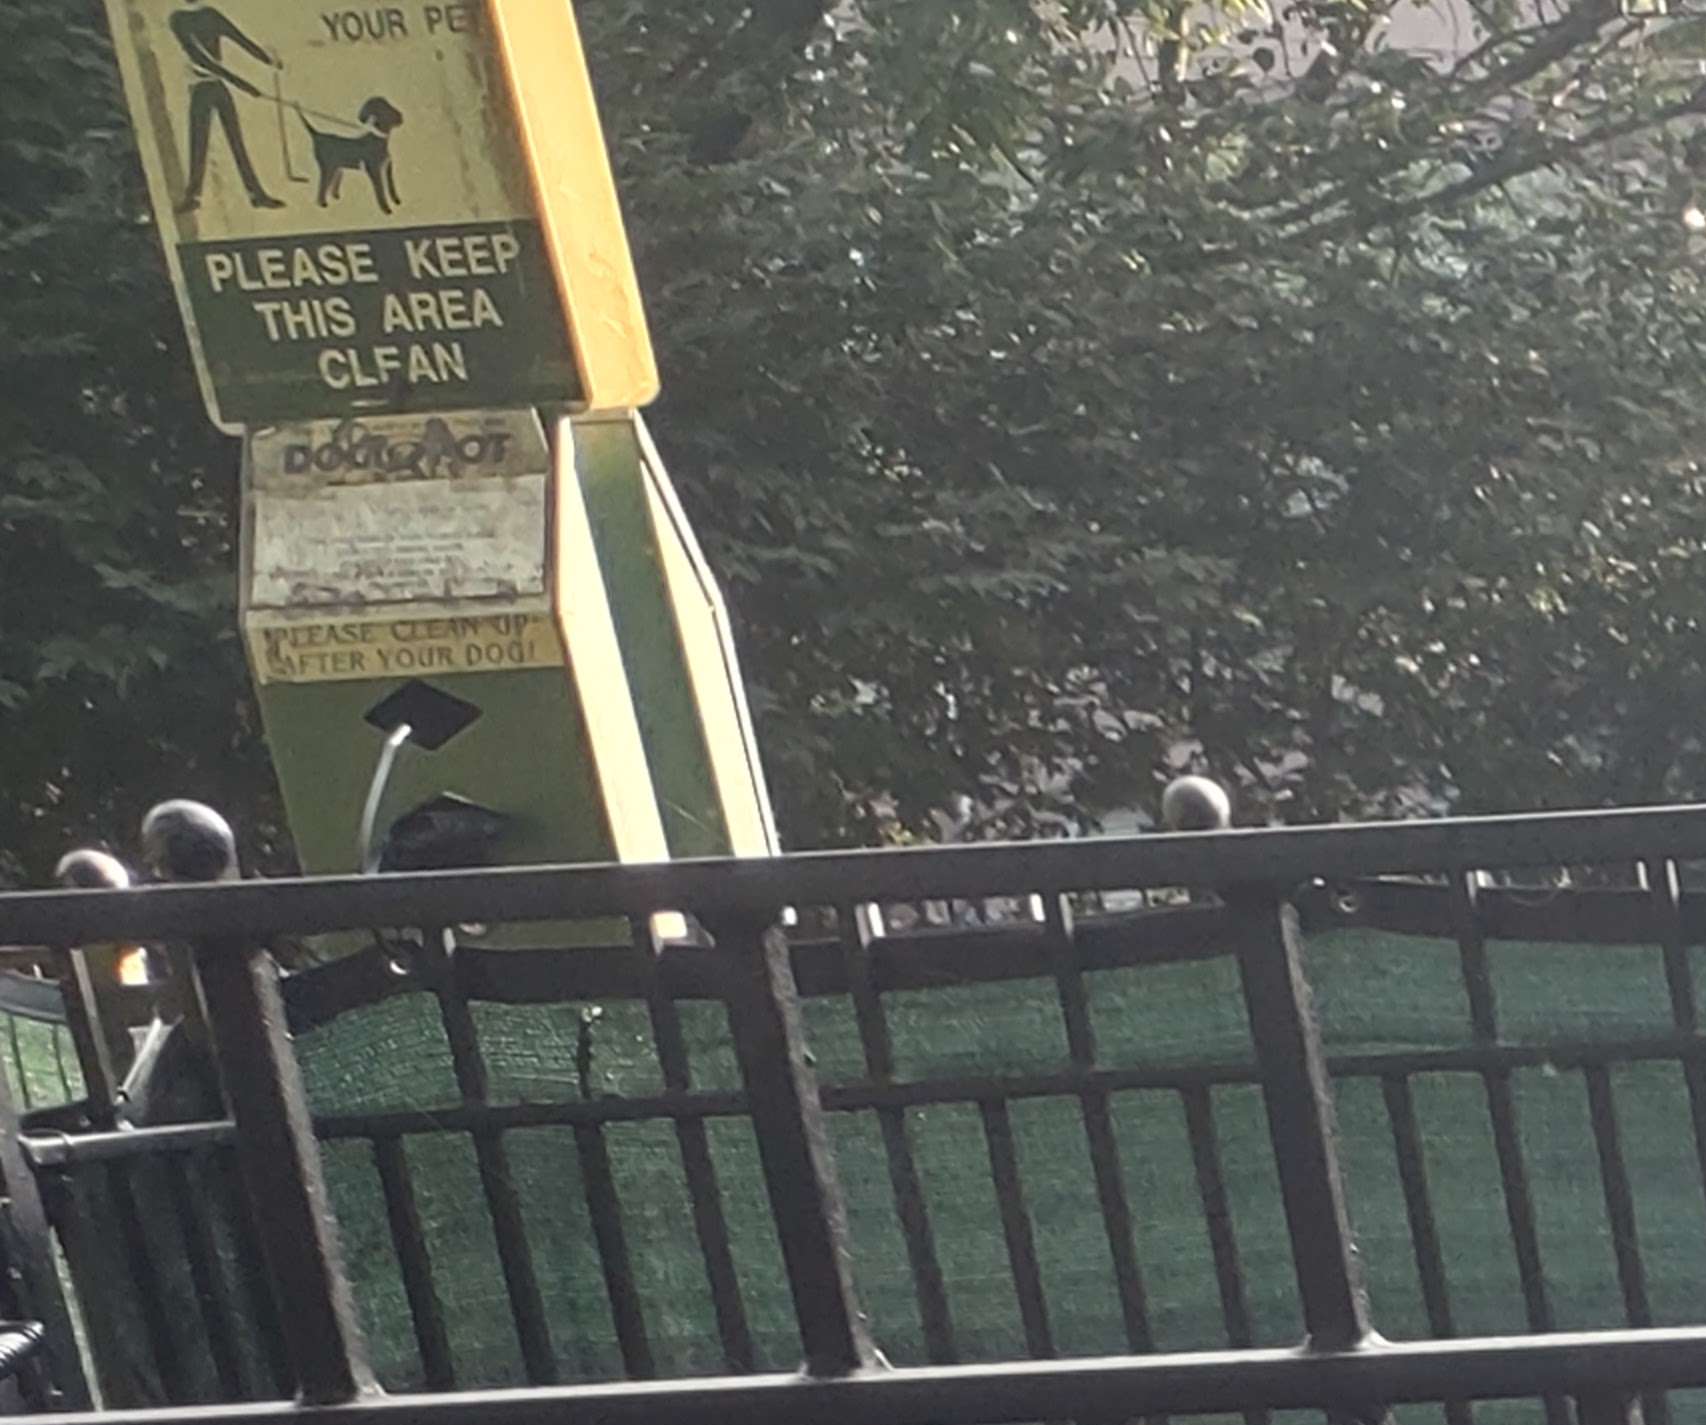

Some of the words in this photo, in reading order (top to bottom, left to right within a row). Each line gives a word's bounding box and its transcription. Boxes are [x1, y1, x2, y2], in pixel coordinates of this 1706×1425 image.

[321, 8, 408, 41] YOUR
[423, 4, 478, 34] PE
[205, 244, 378, 292] PLEASE
[405, 234, 520, 280] KEEP
[254, 297, 356, 342] THIS
[383, 288, 502, 334] AREA
[391, 615, 479, 642] CLEAN
[377, 647, 451, 670] YOUR
